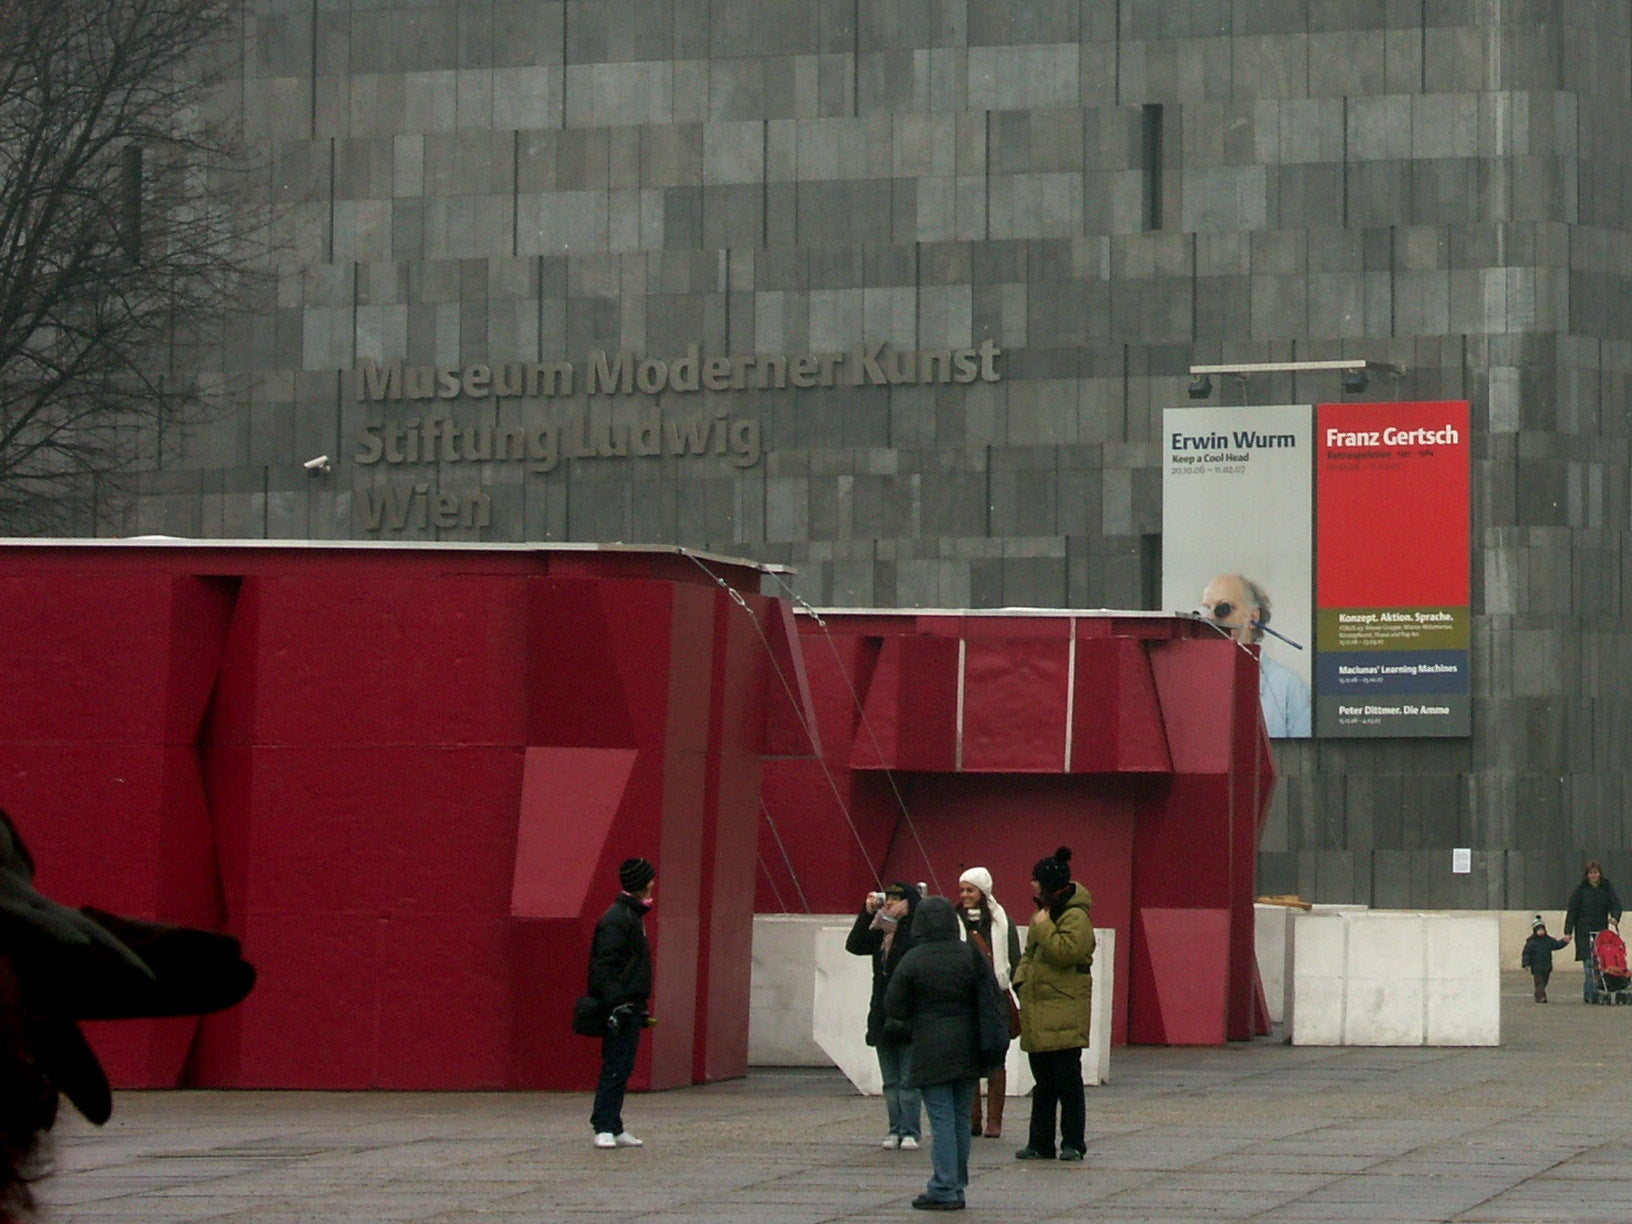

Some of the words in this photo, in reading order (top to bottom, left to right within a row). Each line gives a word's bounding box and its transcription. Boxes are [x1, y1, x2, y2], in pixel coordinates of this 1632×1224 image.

[355, 358, 574, 401] Museum
[587, 343, 843, 393] Moderner
[853, 339, 1001, 385] Kunst
[356, 417, 560, 473] Stiftung
[573, 406, 762, 468] Ludwig
[1172, 432, 1228, 450] Erwin
[1233, 431, 1296, 448] Wurm
[1327, 428, 1380, 446] Franz
[1383, 424, 1458, 445] Gertsch
[1172, 455, 1195, 464] Keep
[1204, 453, 1223, 462] Cool
[1225, 453, 1250, 462] Head
[362, 483, 493, 531] Wien
[1339, 613, 1378, 623] Konzept.
[1380, 612, 1413, 622] Aktion.
[1415, 612, 1453, 623] Sprache.
[1381, 665, 1417, 675] Learning
[1418, 664, 1457, 673] Machines
[1339, 706, 1363, 715] Peter
[1403, 705, 1420, 714] Die
